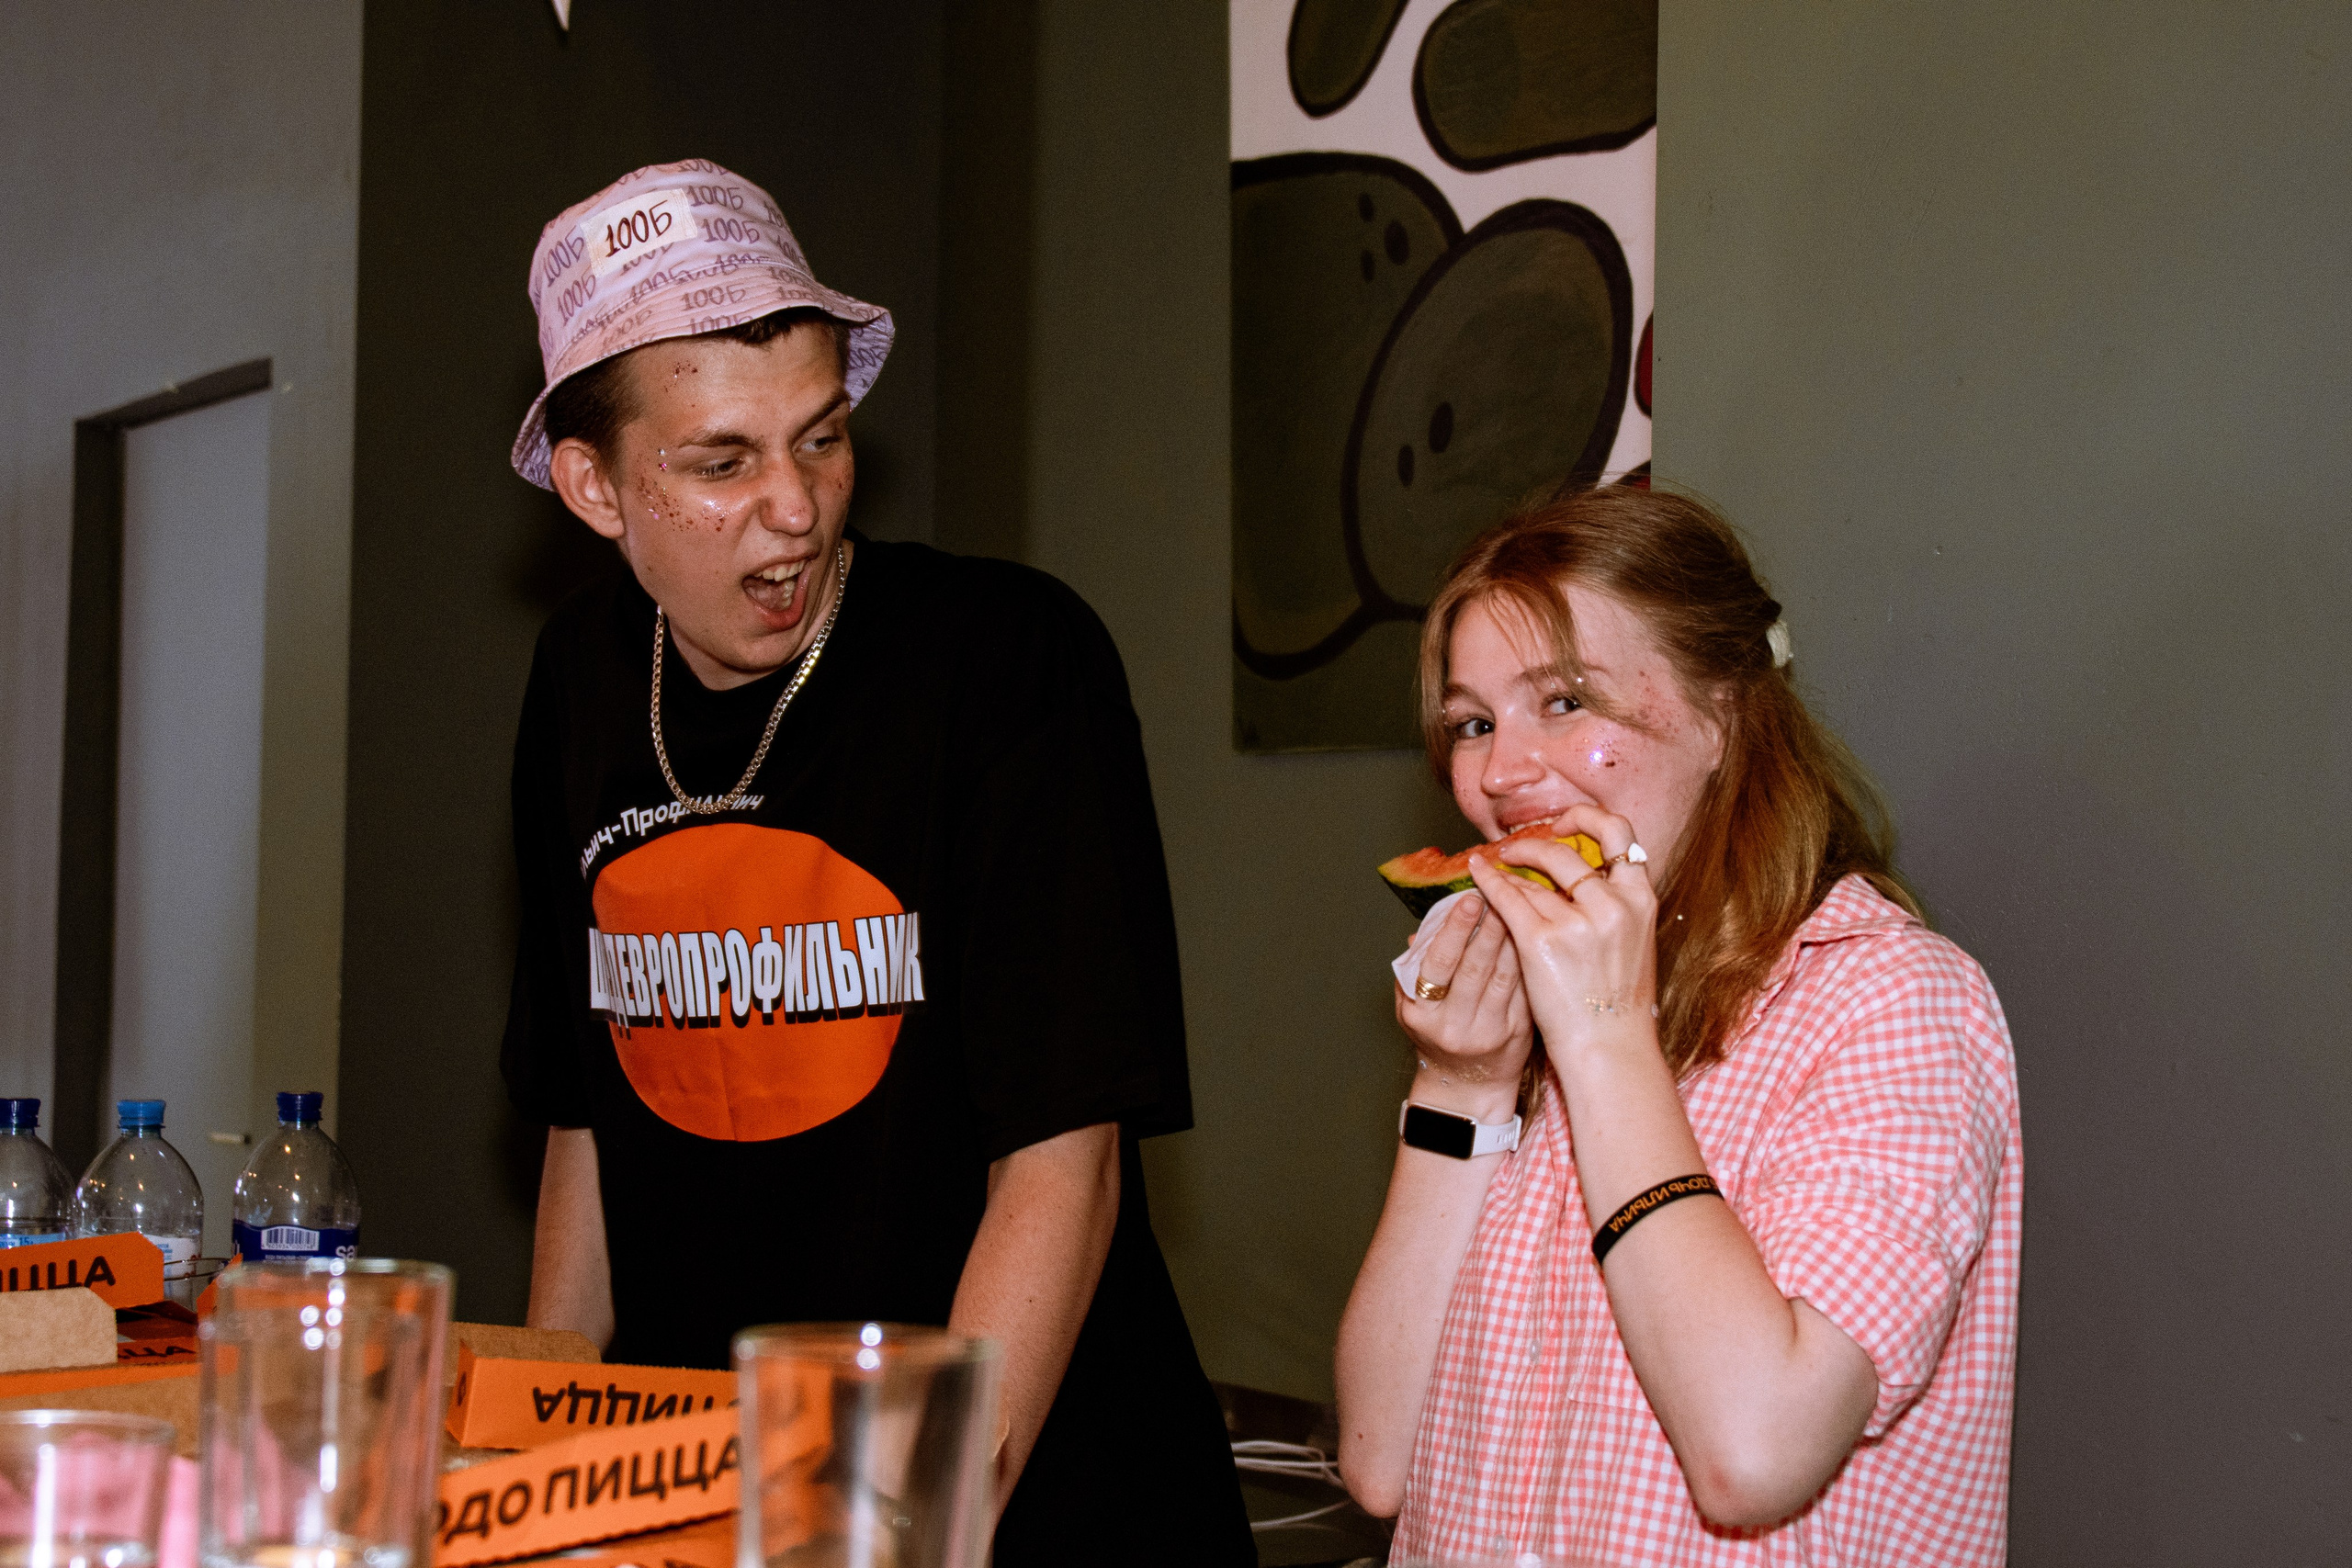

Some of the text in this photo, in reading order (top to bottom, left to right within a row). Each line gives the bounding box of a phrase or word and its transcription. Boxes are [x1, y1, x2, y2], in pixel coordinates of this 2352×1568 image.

[687, 185, 744, 211] 100Б
[605, 199, 673, 258] 100Б
[702, 217, 761, 244] 100Б
[543, 225, 585, 288] 100Б
[556, 265, 596, 327] 100Б
[680, 282, 747, 311] 100Б
[589, 911, 925, 1030] ШДЕВРОПРОФИЛЬНИК
[1608, 1187, 1670, 1233] ИЛЬИЧА
[0, 1256, 116, 1292] ЦЦА
